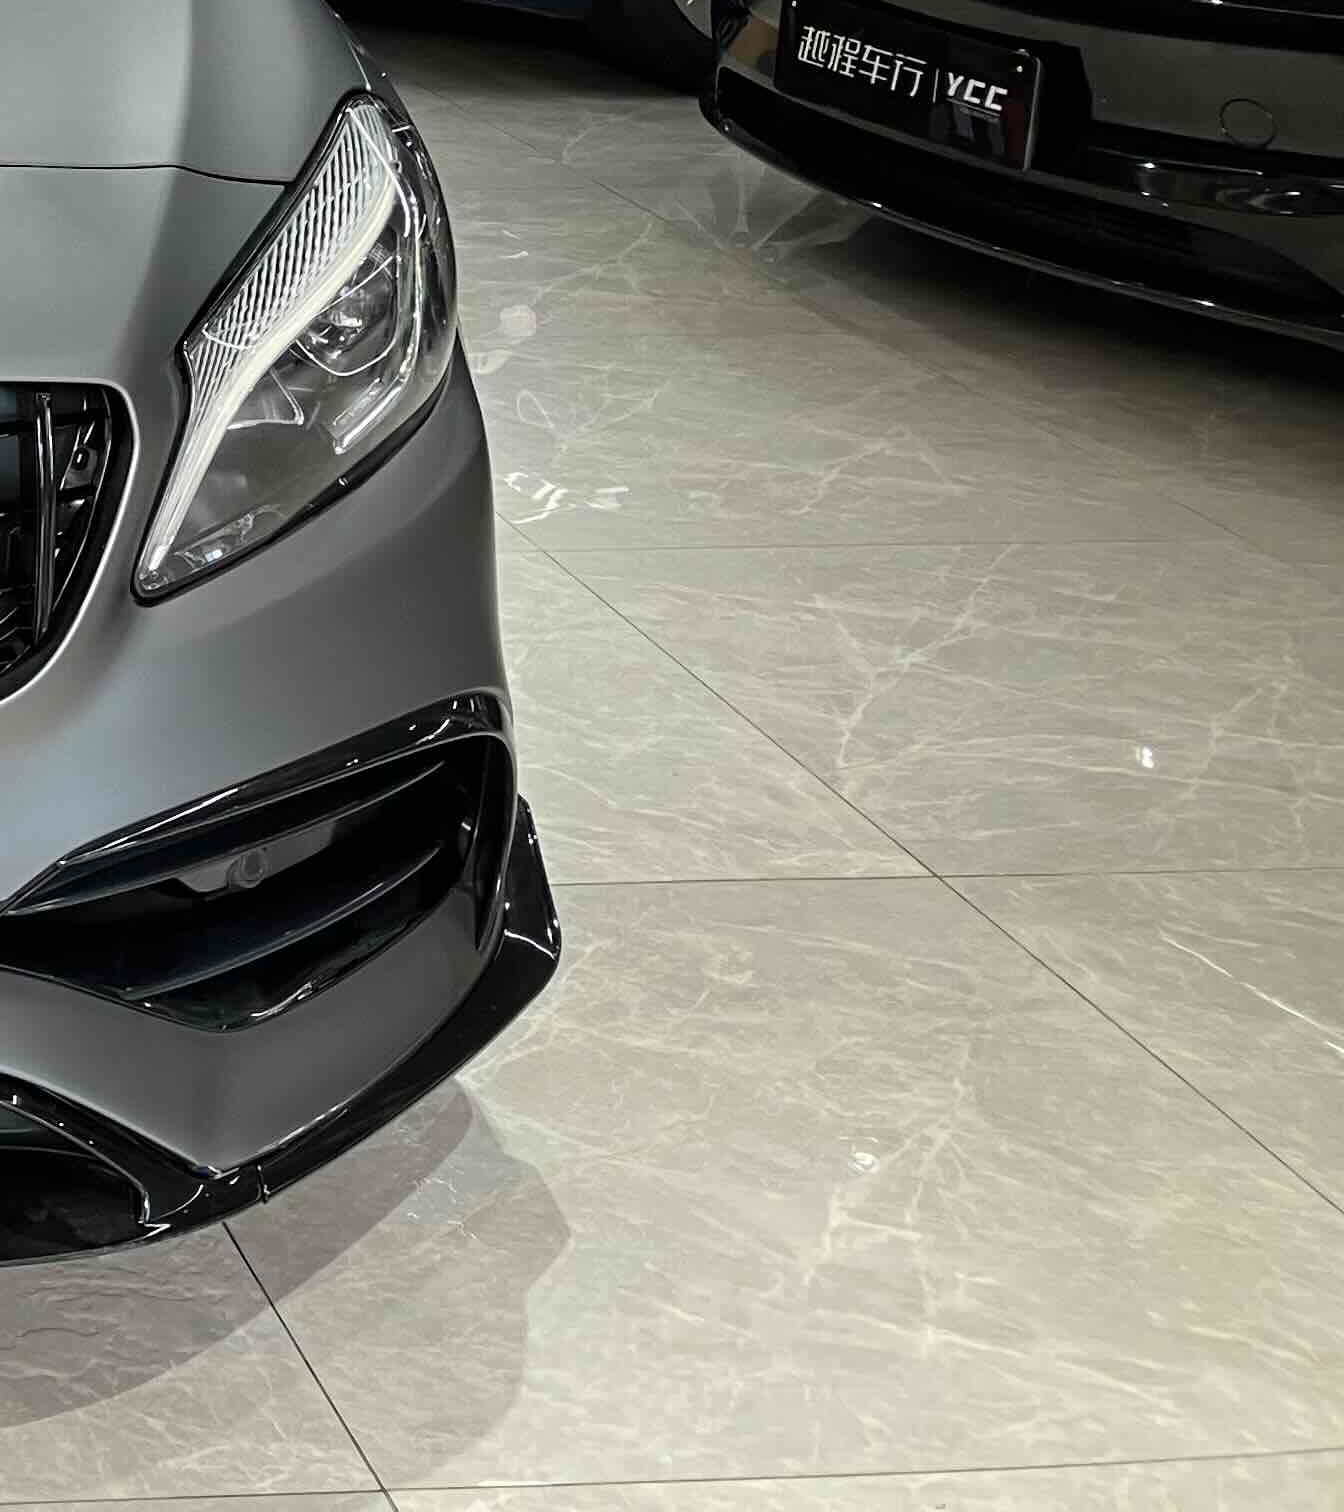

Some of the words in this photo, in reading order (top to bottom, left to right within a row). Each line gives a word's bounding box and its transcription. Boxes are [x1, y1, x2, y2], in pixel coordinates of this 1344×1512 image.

[797, 25, 928, 98] 越程车行
[947, 71, 1009, 112] YCC
